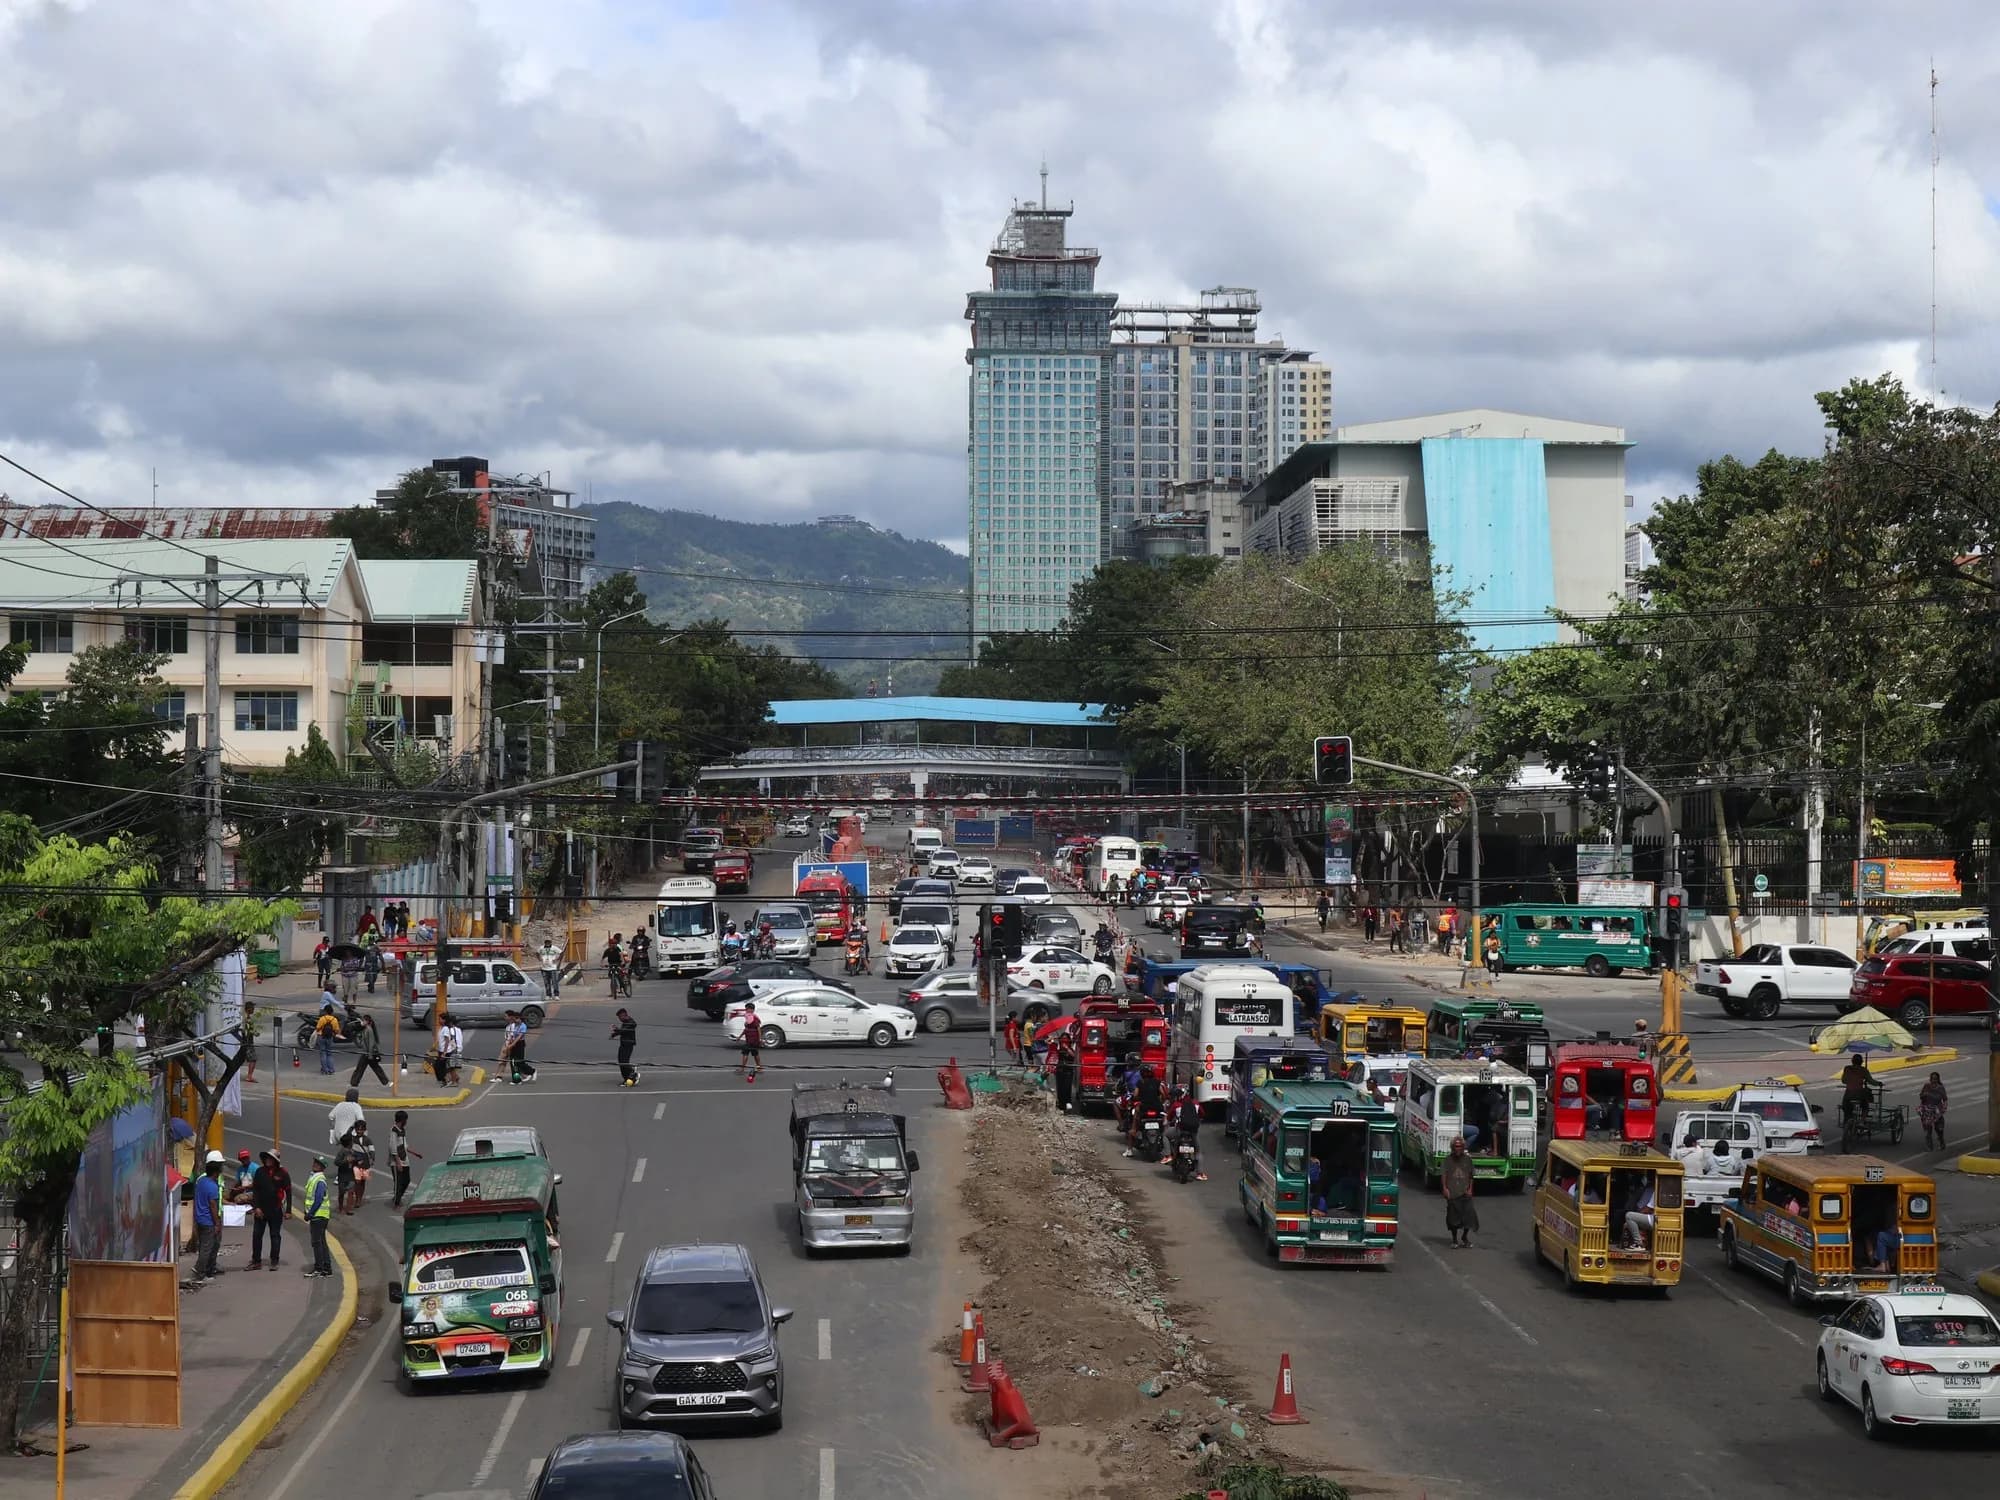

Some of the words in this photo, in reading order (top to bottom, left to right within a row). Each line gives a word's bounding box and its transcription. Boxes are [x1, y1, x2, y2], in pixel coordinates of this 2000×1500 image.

[790, 1014, 808, 1024] 1473
[1229, 1014, 1269, 1022] LATRANSCO
[1334, 1102, 1349, 1116] 17B
[438, 1282, 460, 1290] LADY
[462, 1280, 475, 1289] OF
[476, 1275, 529, 1288] GUADALUPE
[1946, 1377, 1958, 1385] GAL
[1962, 1377, 1980, 1386] 2594
[679, 1396, 697, 1404] GAK
[701, 1394, 723, 1404] 1067
